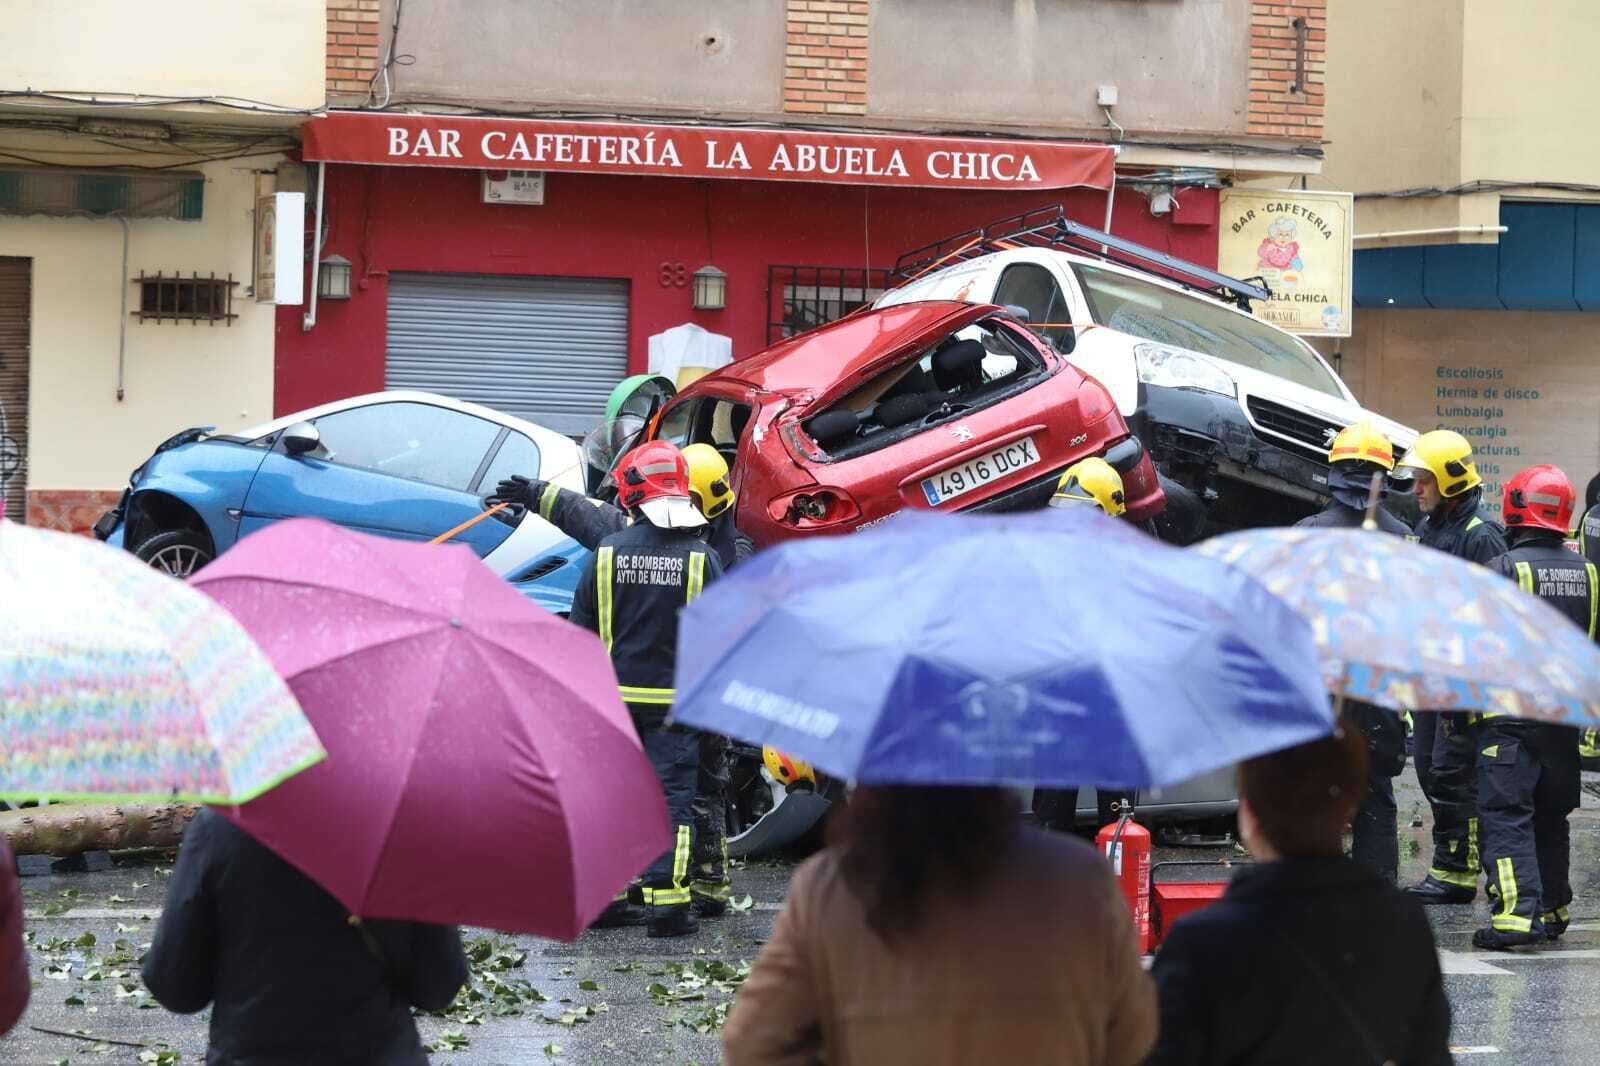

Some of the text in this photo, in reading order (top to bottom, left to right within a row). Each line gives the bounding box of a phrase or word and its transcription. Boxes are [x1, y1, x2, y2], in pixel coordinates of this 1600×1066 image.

[388, 127, 1042, 182] BAR CAFETERÍA LA ABUELA CHICA
[1231, 209, 1257, 234] BAR
[1294, 293, 1328, 304] CHICA
[1436, 366, 1504, 380] Escoliosis
[1436, 387, 1540, 400] Hernia de disco
[1436, 405, 1504, 420] Lumbalgia
[1472, 444, 1520, 456] acturas
[940, 460, 990, 496] 4916
[992, 441, 1034, 473] DCX
[616, 555, 684, 572] RC BOMBEROS
[616, 569, 682, 586] AYTO DE MALAGA
[1549, 568, 1587, 583] BOMBEROS
